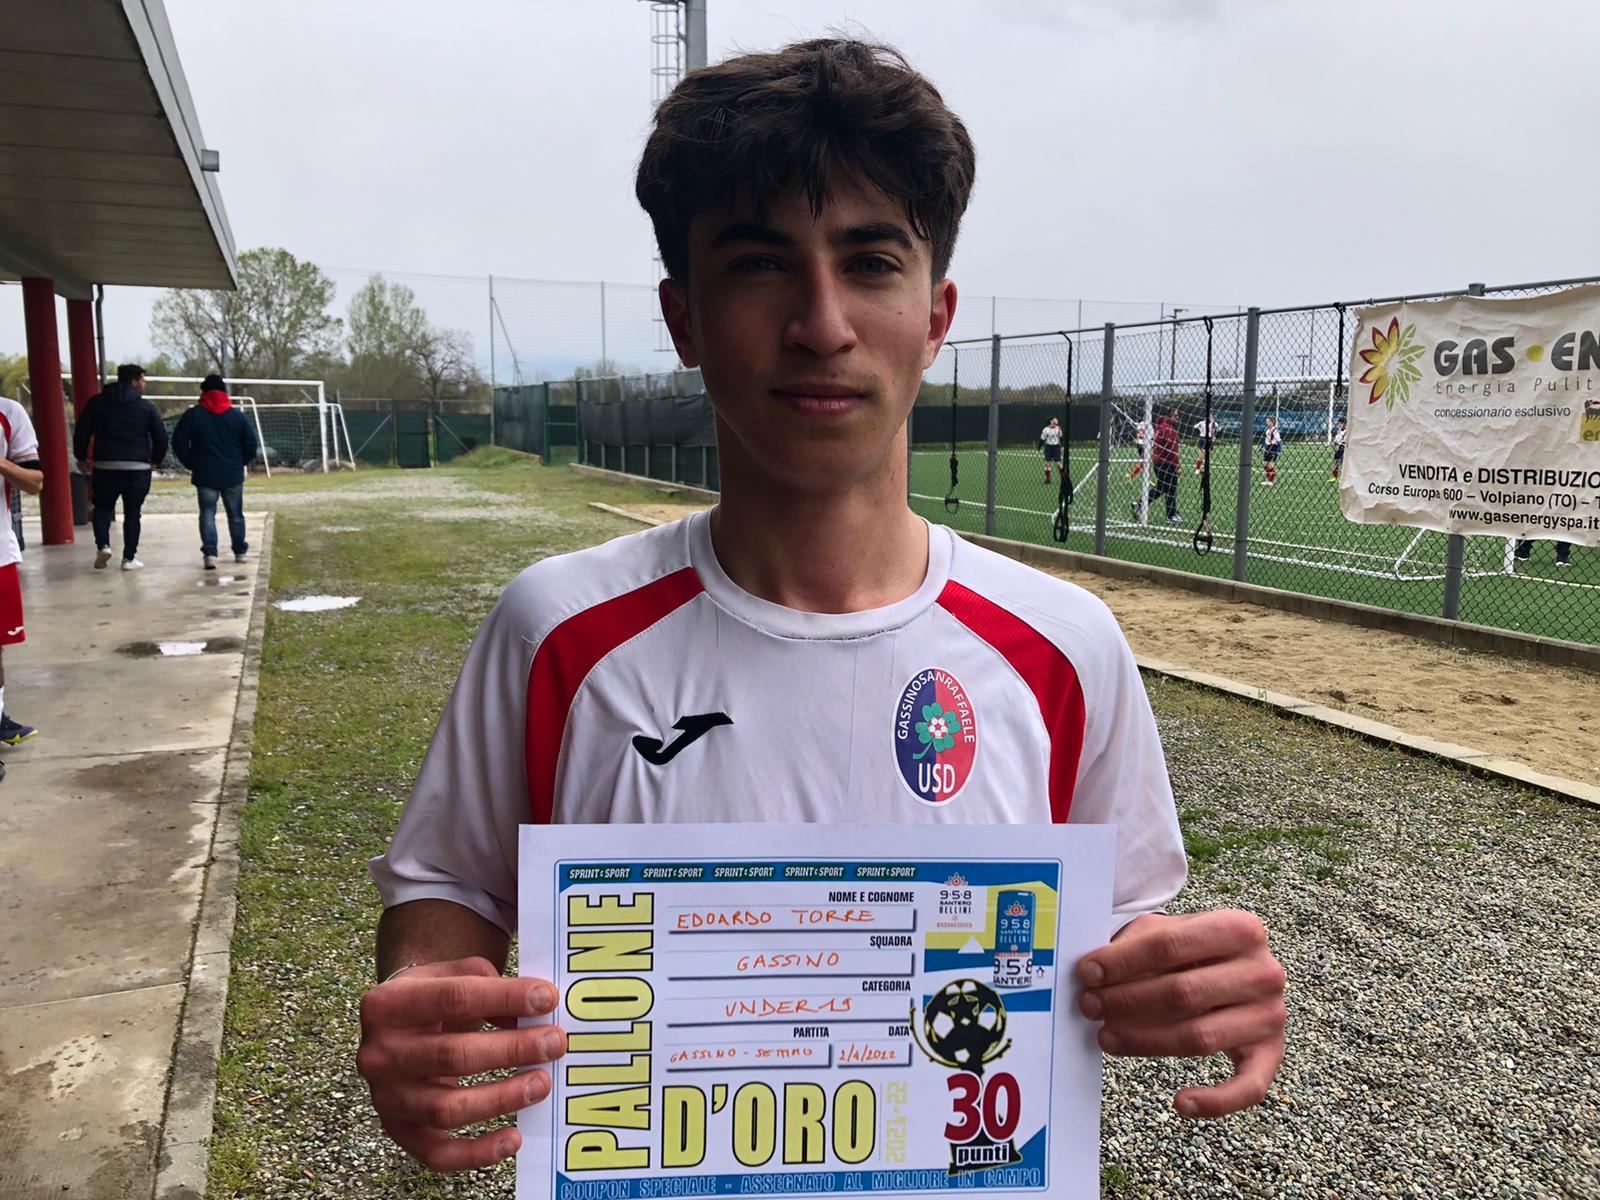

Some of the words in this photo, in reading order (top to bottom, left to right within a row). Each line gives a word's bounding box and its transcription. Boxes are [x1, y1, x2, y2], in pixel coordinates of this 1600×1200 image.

[1433, 337, 1515, 376] GAS
[1436, 381, 1515, 396] Energia
[1534, 376, 1592, 391] Pulit
[1434, 405, 1512, 417] concessionario
[1515, 404, 1571, 417] esclusivo
[1399, 464, 1458, 482] VENDITA
[1463, 471, 1473, 483] e
[1478, 468, 1600, 489] DISTRIBUZIO
[1368, 483, 1399, 496] Corso
[1403, 485, 1441, 501] Europa
[1443, 488, 1463, 500] 600
[1480, 490, 1544, 506] Volpiano
[1549, 493, 1577, 510] (TO)
[1449, 509, 1600, 530] www.gasenergyspa.it
[897, 670, 976, 743] GASSINOSANRAFFAELE
[918, 763, 956, 794] USD
[569, 868, 600, 879] SPRINT
[604, 867, 630, 878] SPORT
[643, 868, 674, 878] SPRINT
[677, 867, 703, 878] SPORT
[714, 867, 744, 877] SPRINT
[749, 867, 774, 877] SPORT
[785, 867, 814, 877] SPRINT
[819, 867, 844, 877] SPORT
[857, 867, 886, 877] SPRINT
[890, 867, 915, 877] SPORT
[828, 892, 857, 903] NOME
[860, 892, 865, 902] E
[868, 891, 914, 902] COGNOME
[677, 911, 772, 929] EDOARDO
[791, 909, 875, 924] TORRE
[869, 936, 912, 948] SQUADRA
[736, 952, 839, 971] GASSINO
[862, 980, 911, 992] CATEGORIA
[565, 892, 655, 1172] PALLONE
[793, 1026, 830, 1038] PARTITA
[888, 1025, 910, 1037] DATA
[670, 1047, 736, 1064] GASSINO
[944, 1072, 1022, 1142] 30
[886, 1081, 907, 1164] 2021-22
[957, 1144, 1009, 1166] punti
[561, 1180, 630, 1200] COUPON
[639, 1176, 717, 1197] SPECIALE
[740, 1173, 834, 1193] ASSEGNATO
[844, 1173, 863, 1190] AL
[872, 1169, 949, 1189] MIGLIORE
[957, 1169, 975, 1187] IN
[984, 1167, 1041, 1186] CAMPO
